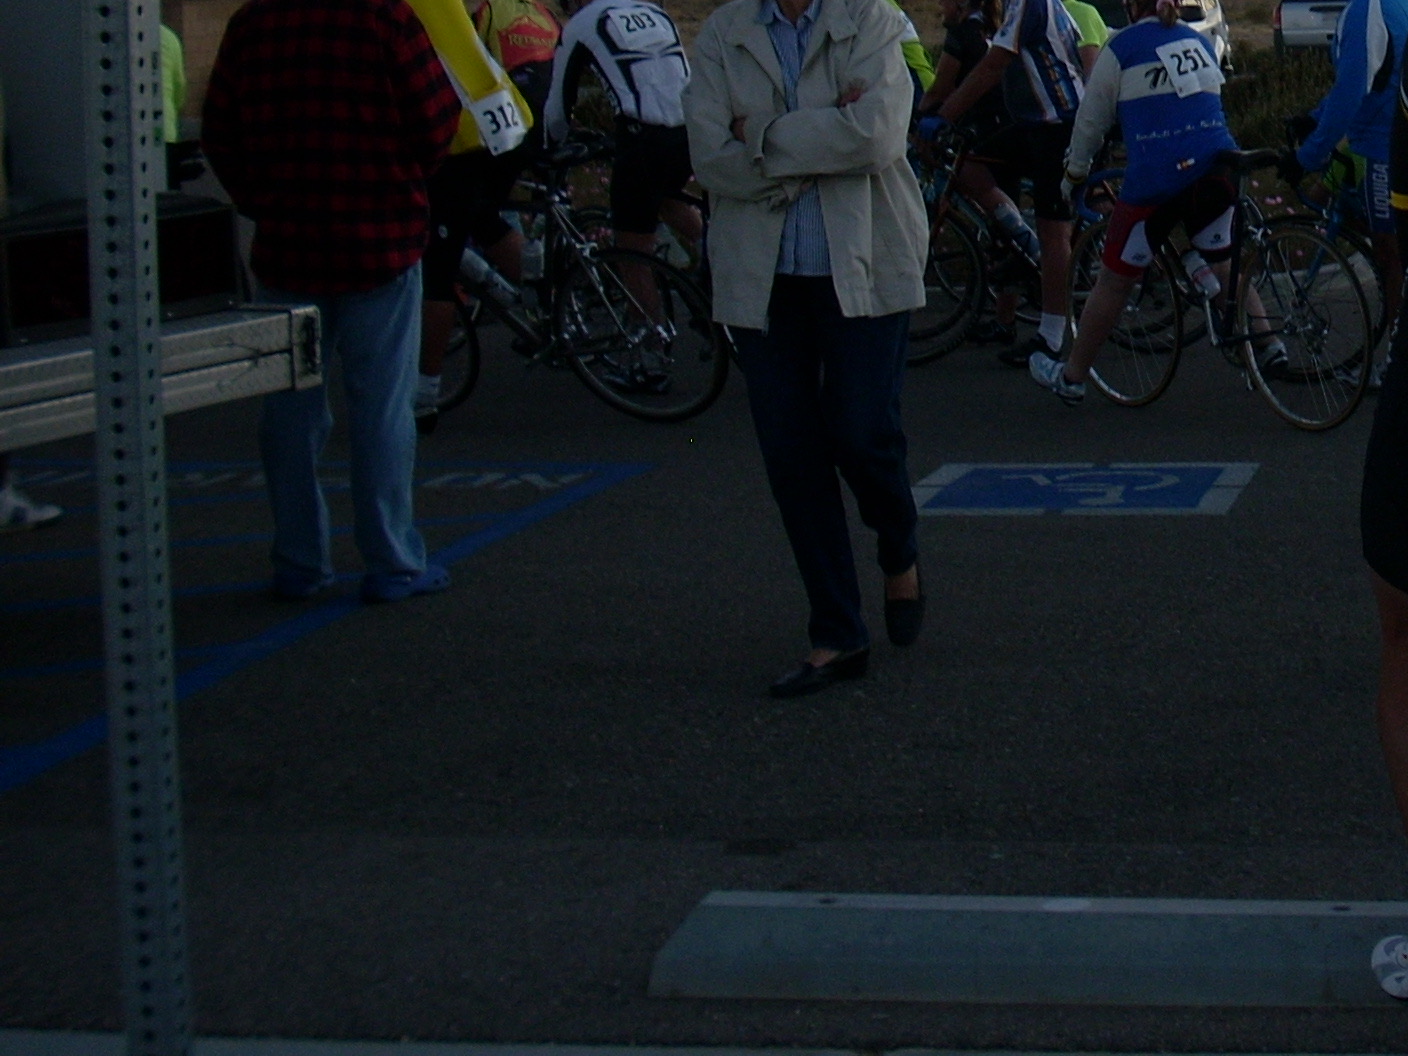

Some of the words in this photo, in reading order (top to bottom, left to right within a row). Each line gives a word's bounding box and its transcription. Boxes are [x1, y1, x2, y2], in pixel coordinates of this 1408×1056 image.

[619, 12, 657, 33] 203
[1170, 47, 1210, 75] 251
[483, 102, 519, 136] 312
[1372, 163, 1391, 219] LIQUIGA
